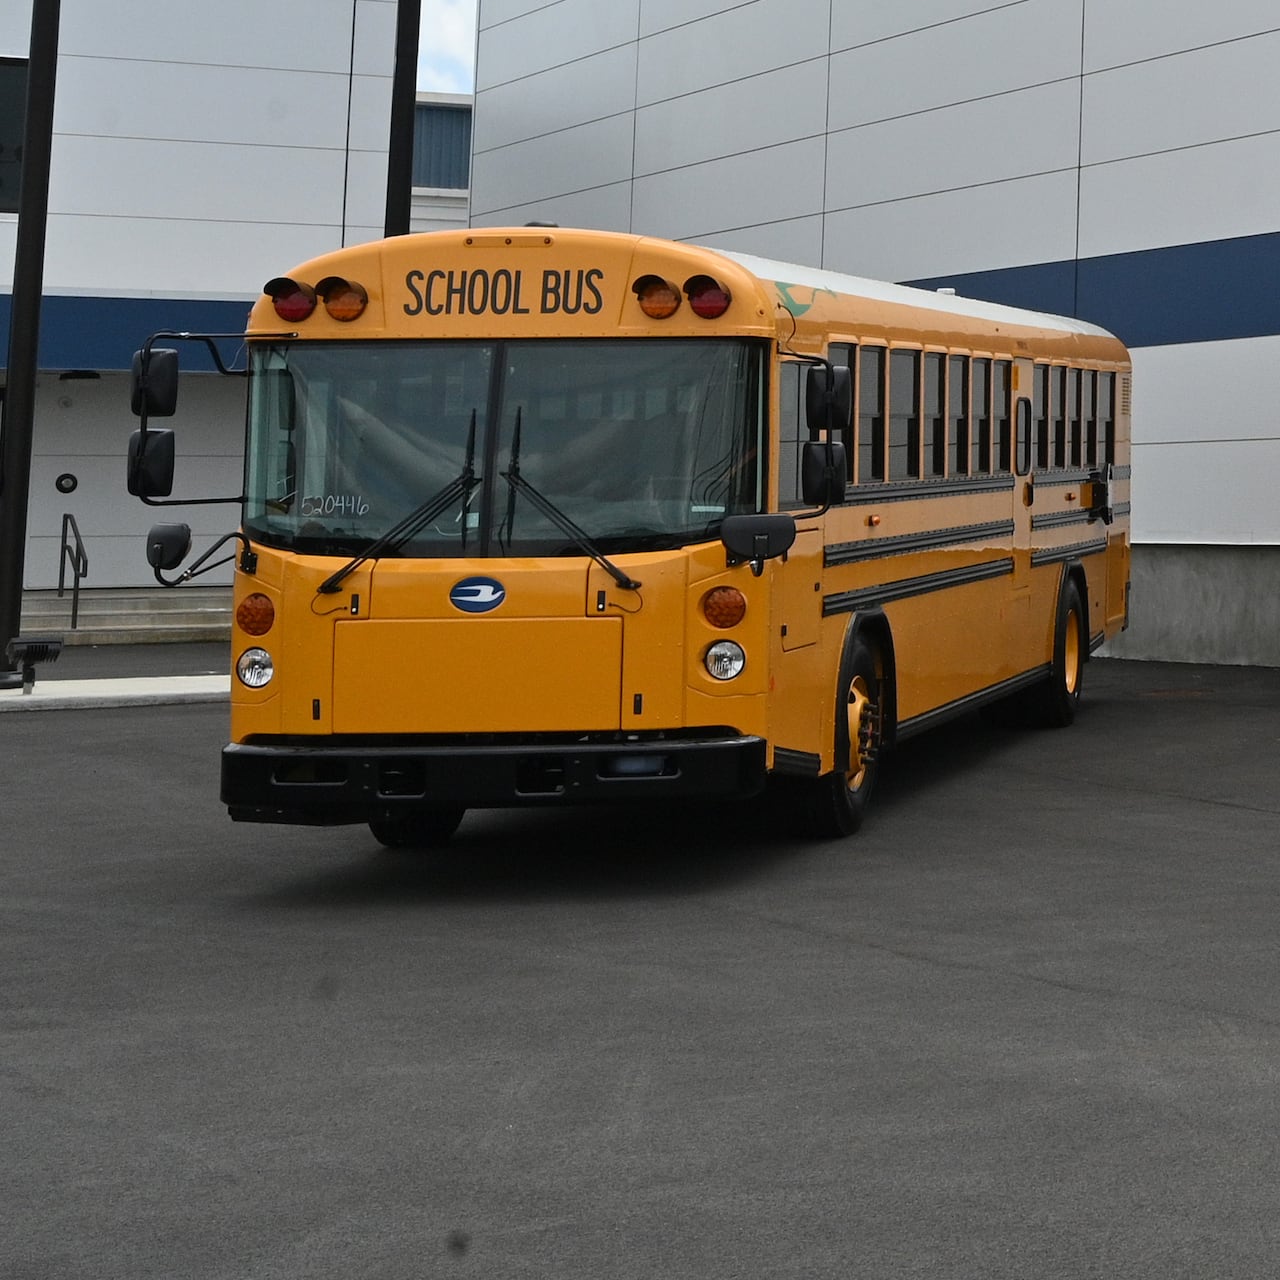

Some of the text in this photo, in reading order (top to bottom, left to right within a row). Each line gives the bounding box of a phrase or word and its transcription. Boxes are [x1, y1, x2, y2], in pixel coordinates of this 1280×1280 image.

[403, 269, 604, 315] SCHOOL BUS
[301, 495, 370, 517] 520446
